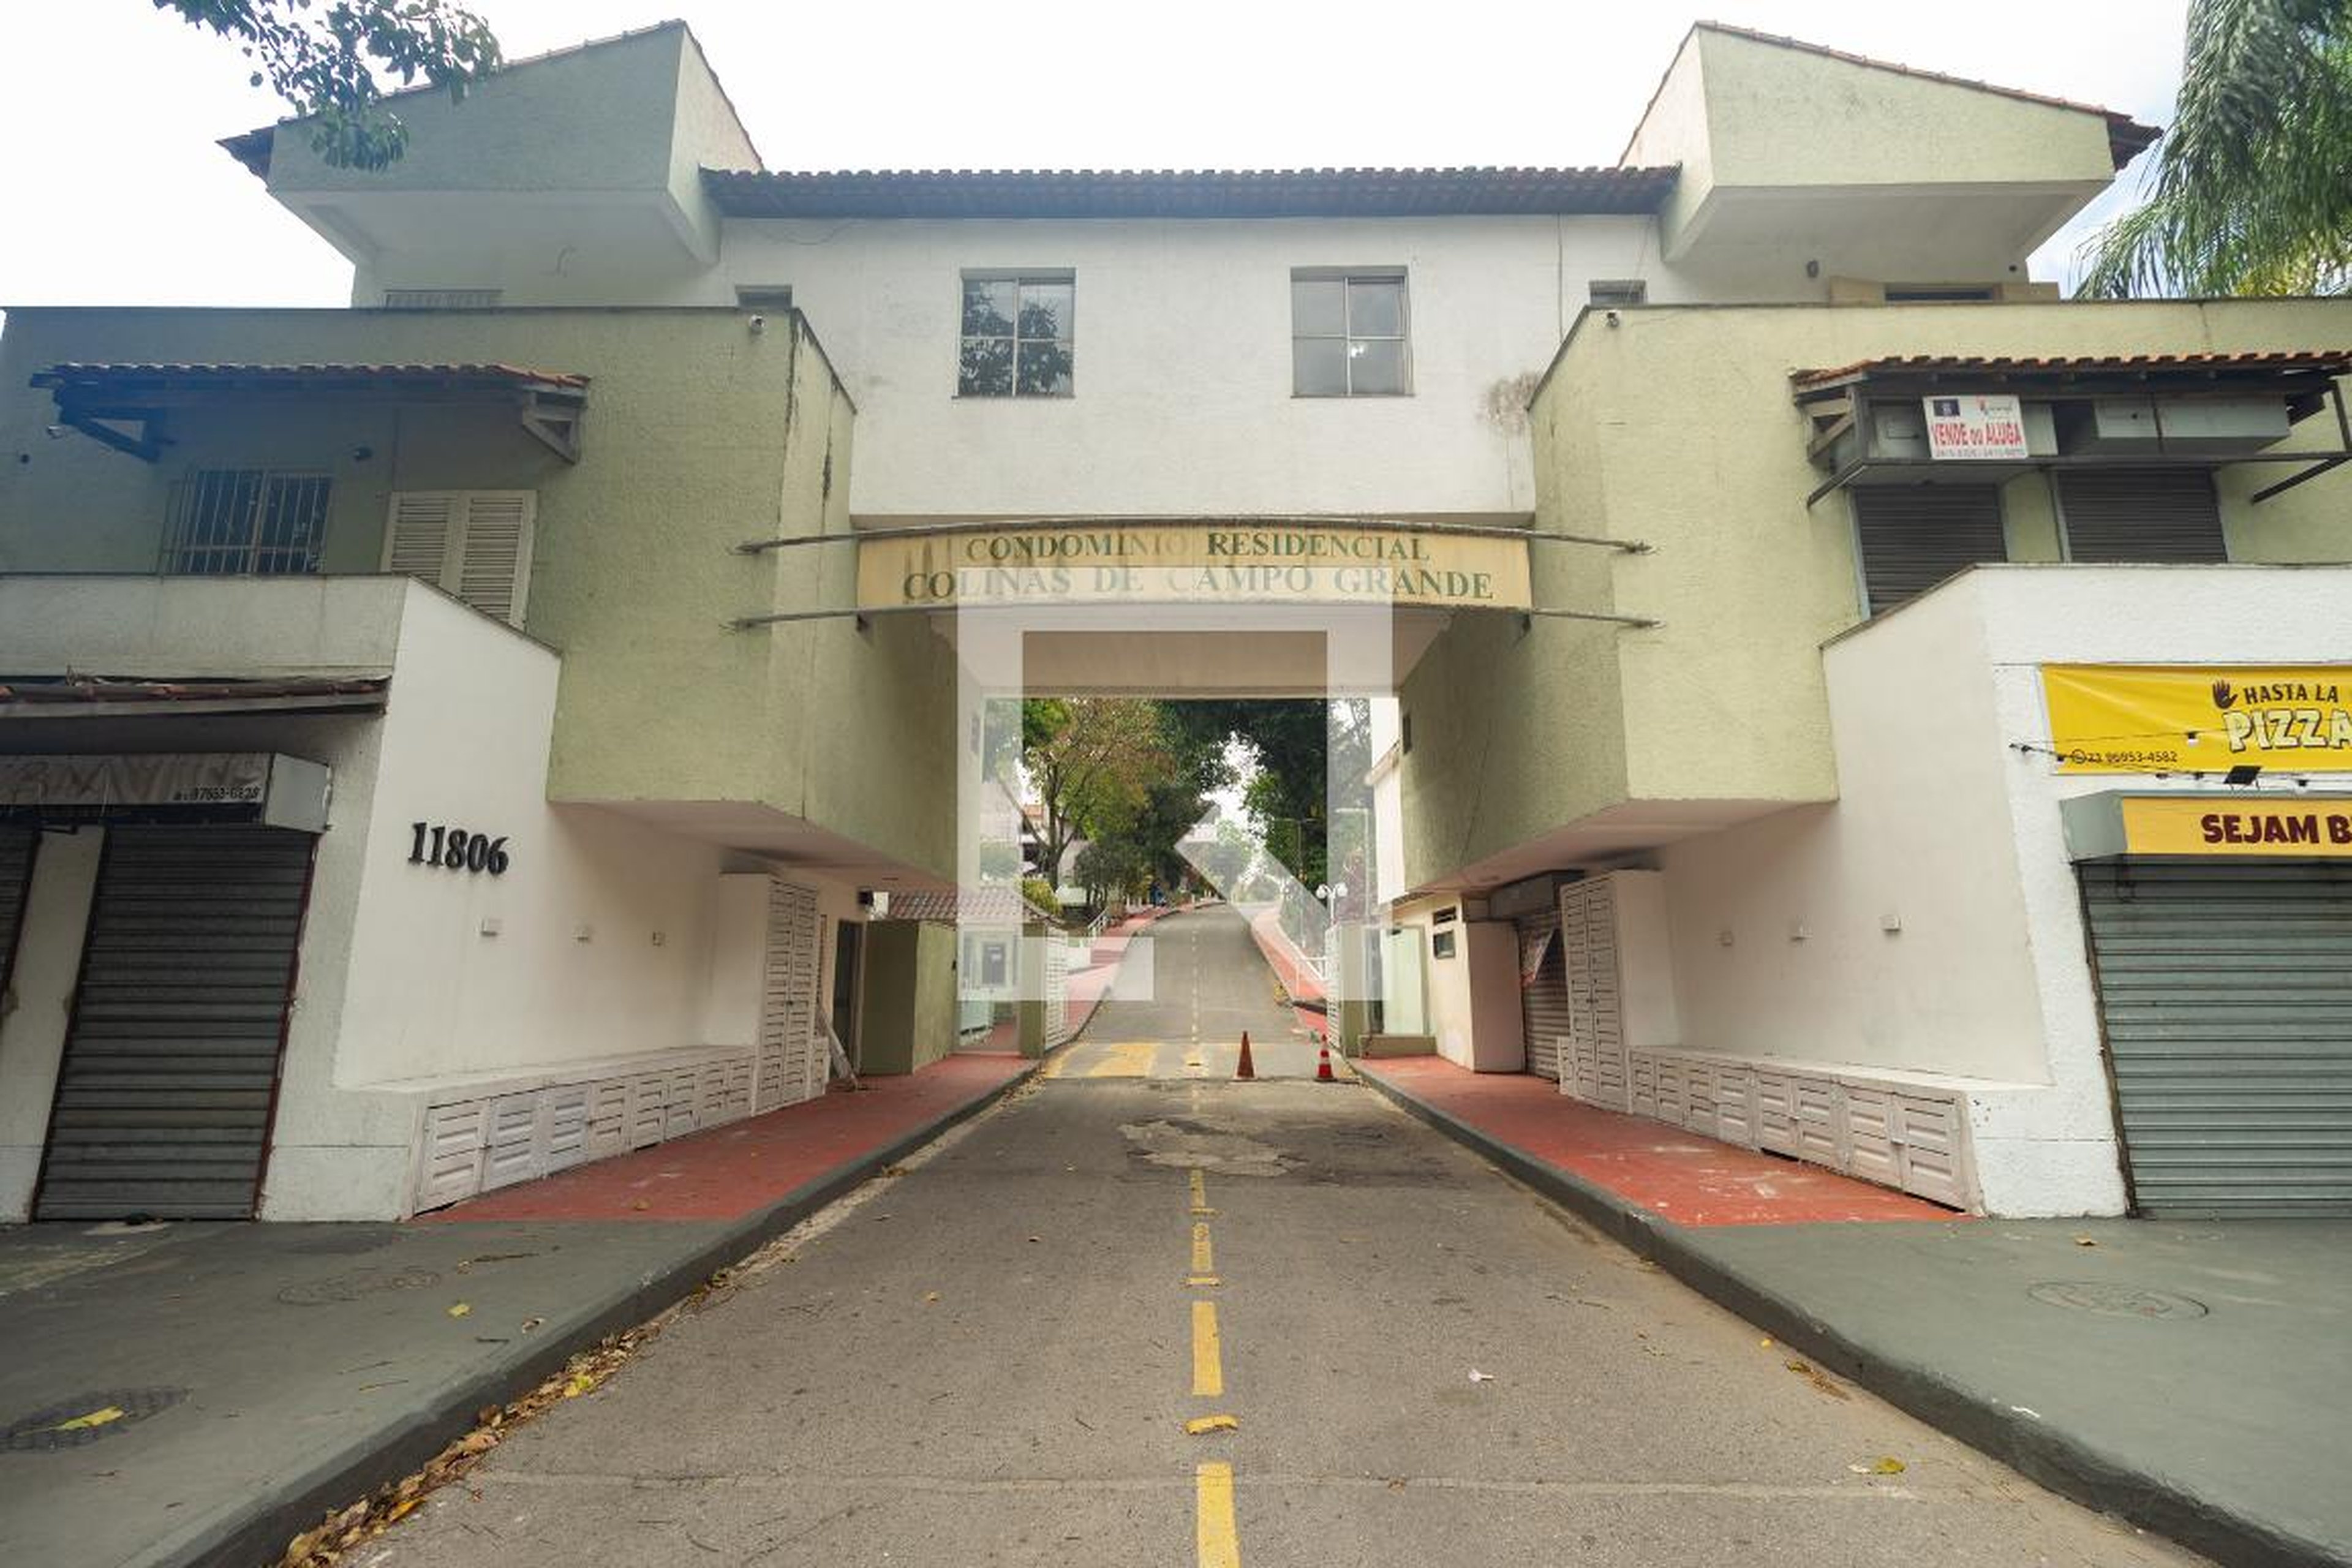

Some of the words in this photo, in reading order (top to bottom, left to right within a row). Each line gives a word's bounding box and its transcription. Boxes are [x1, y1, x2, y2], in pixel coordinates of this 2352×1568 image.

[1207, 532, 1430, 561] RESIDENCIAL
[903, 567, 1072, 601] COLINAS
[1094, 565, 1145, 593] DE
[1167, 564, 1314, 593] CAMPO
[1334, 566, 1494, 600] GRANDE
[2244, 684, 2309, 704] HASTA
[2315, 685, 2339, 703] LA
[2222, 708, 2352, 753] PIZZA
[2201, 813, 2320, 845] SEJAM
[408, 822, 510, 875] 11806
